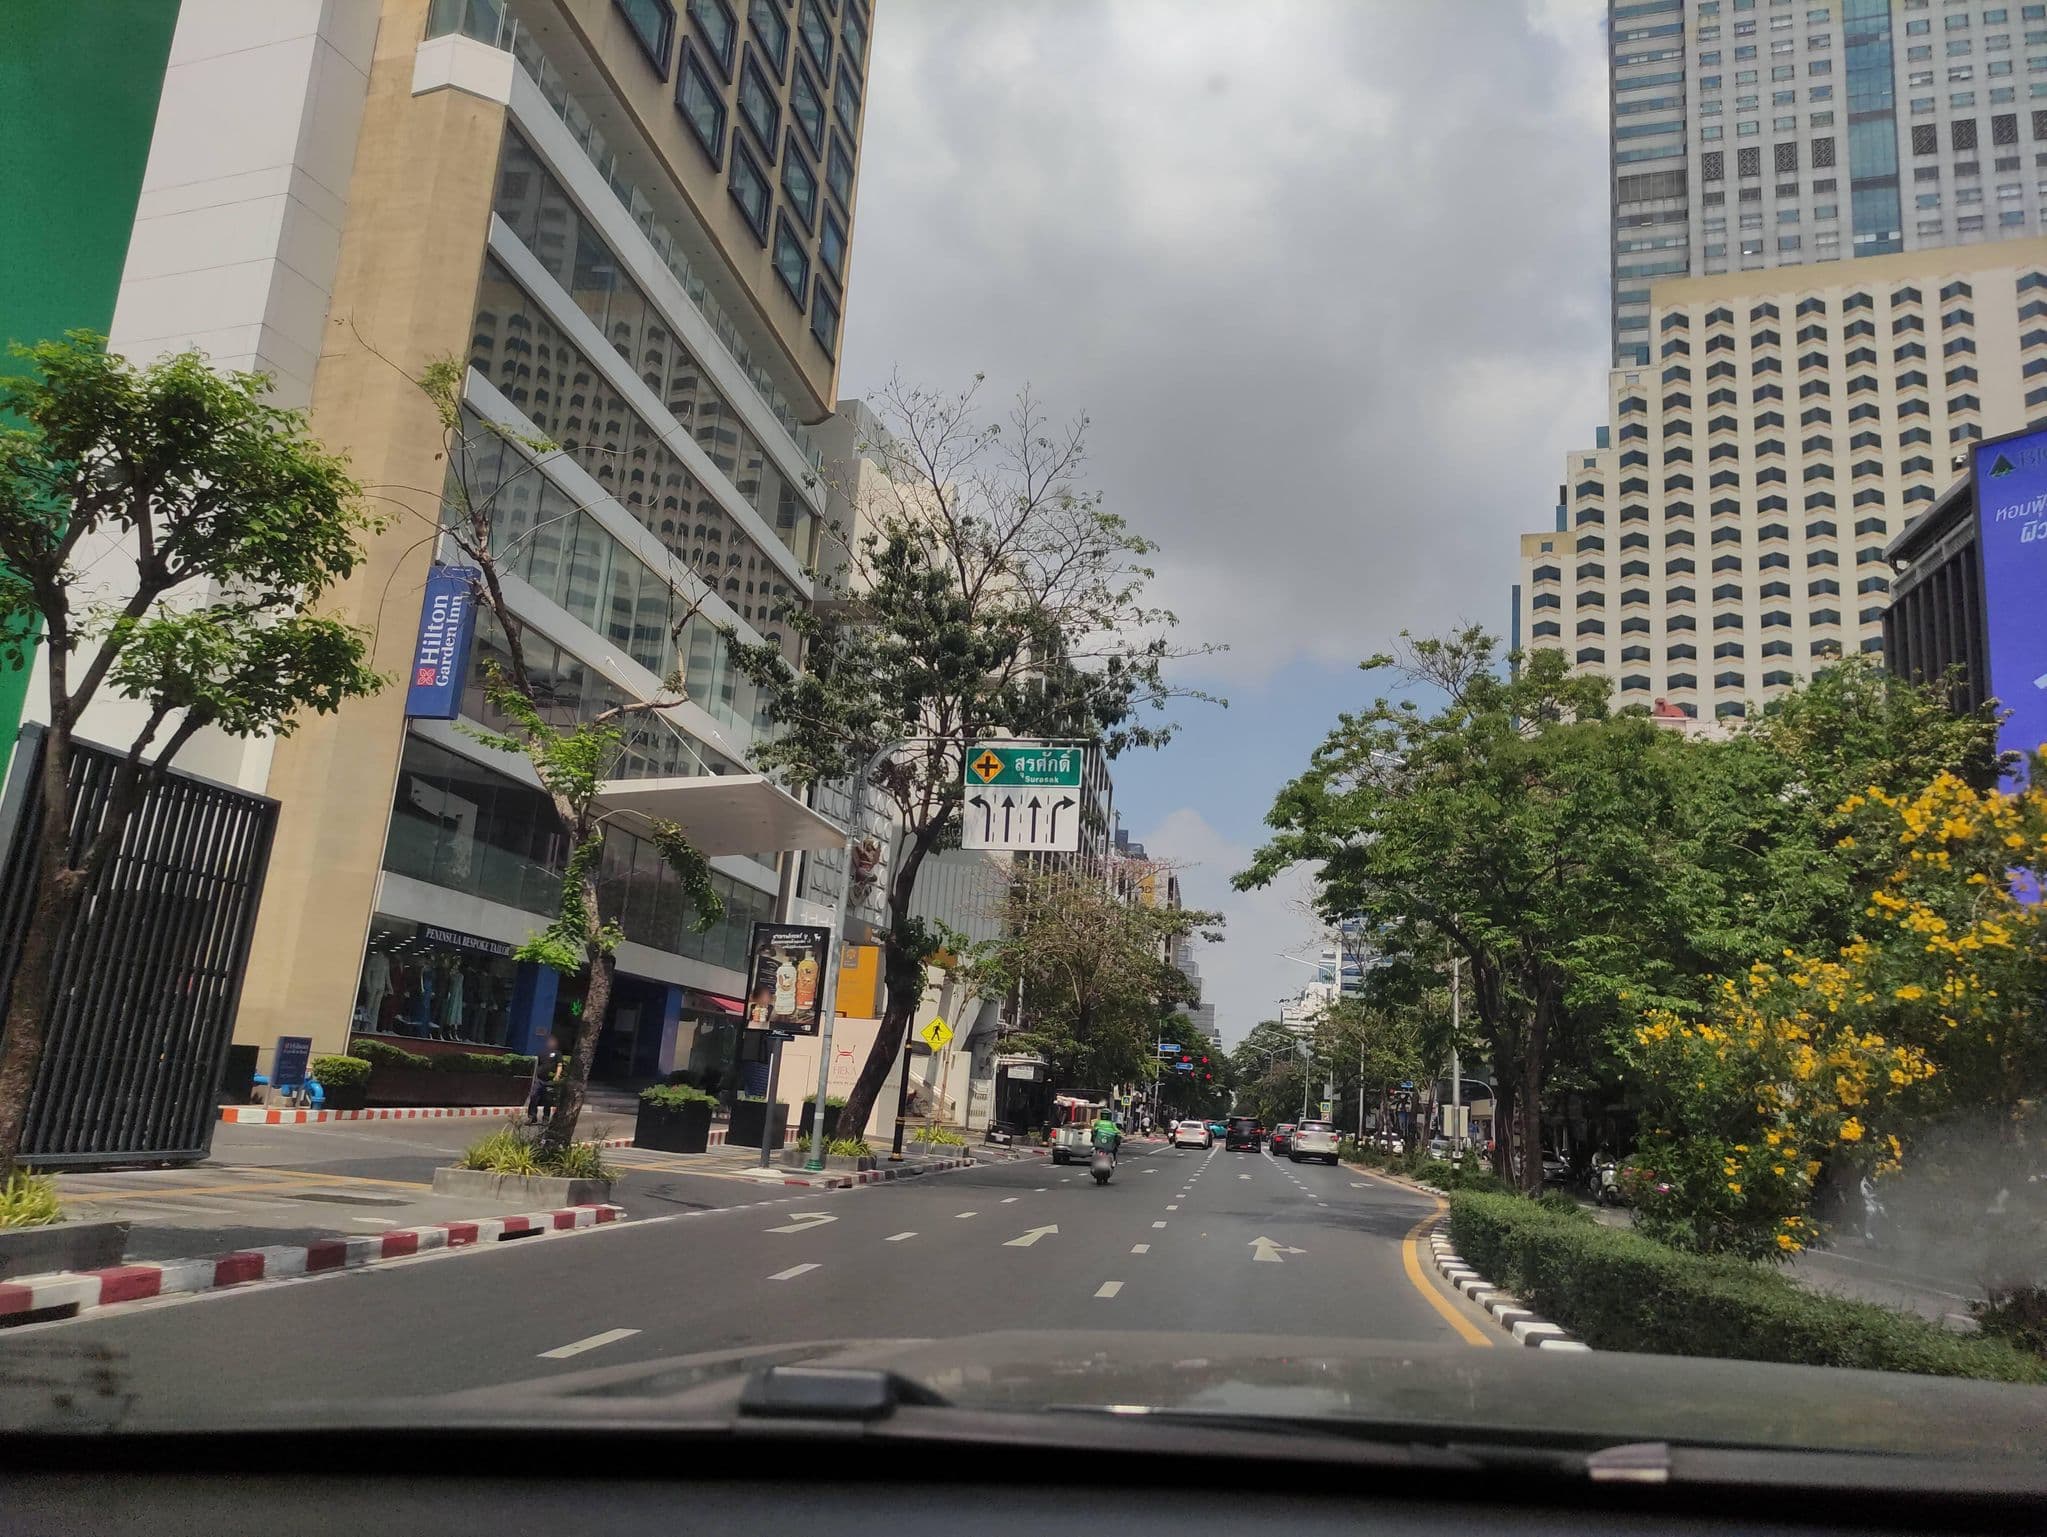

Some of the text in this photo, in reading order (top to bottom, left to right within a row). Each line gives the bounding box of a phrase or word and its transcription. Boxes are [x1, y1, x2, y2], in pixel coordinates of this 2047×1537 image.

[1995, 493, 2047, 522] หอมฟุ้
[446, 595, 463, 624] Inn
[419, 594, 449, 665] Hilton
[435, 625, 458, 687] Garden
[1014, 749, 1072, 778] สุรศักดิ์
[1024, 775, 1060, 783] Surasak
[425, 927, 462, 945] PENINSULA
[462, 935, 489, 952] BESPOKE
